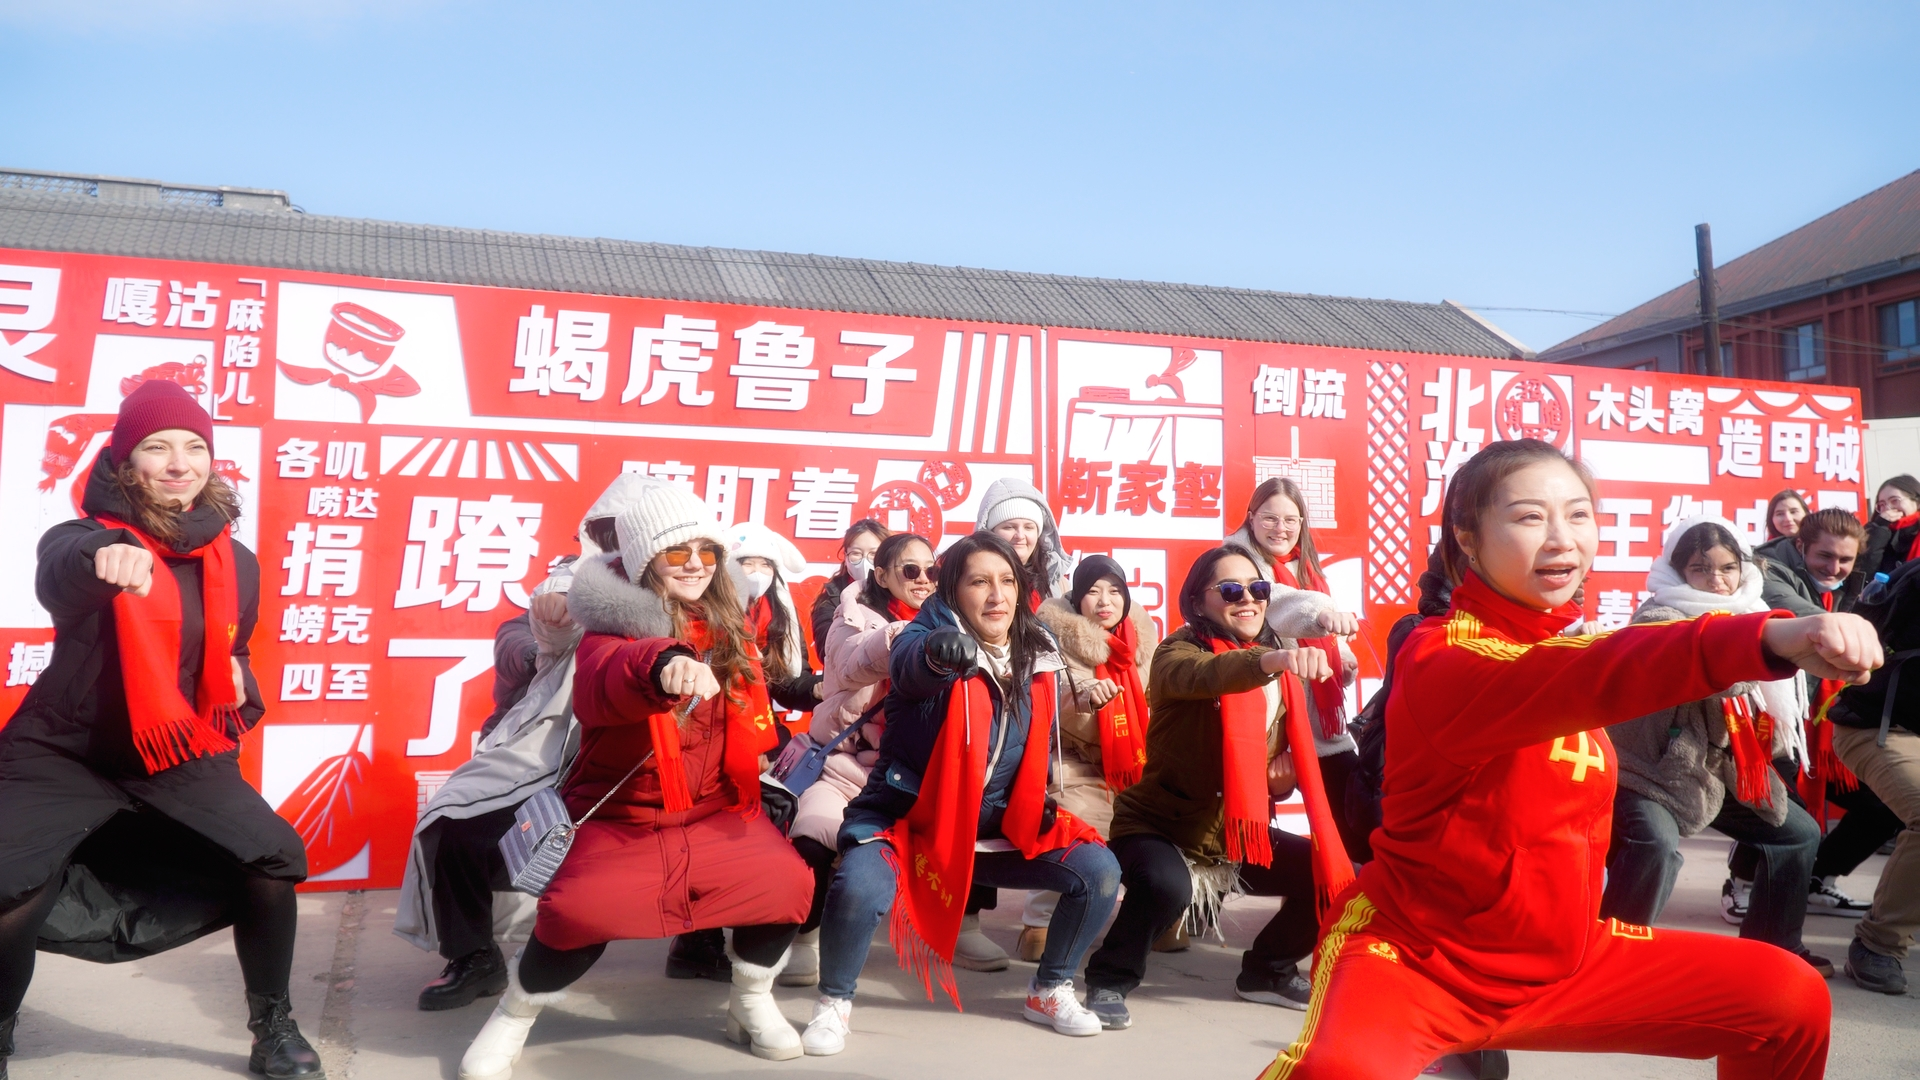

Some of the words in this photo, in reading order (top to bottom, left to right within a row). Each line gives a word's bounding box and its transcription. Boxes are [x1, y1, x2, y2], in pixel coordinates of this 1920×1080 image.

[509, 304, 917, 416] 蝎虎鲁子
[1252, 364, 1346, 419] 倒流
[1587, 384, 1705, 436] 木头窝
[276, 438, 370, 480] 各叽
[1717, 417, 1860, 485] 造甲城
[307, 486, 379, 518] 唠达
[280, 522, 364, 597] 捐
[279, 603, 373, 644] 螃克
[280, 663, 371, 702] 四至
